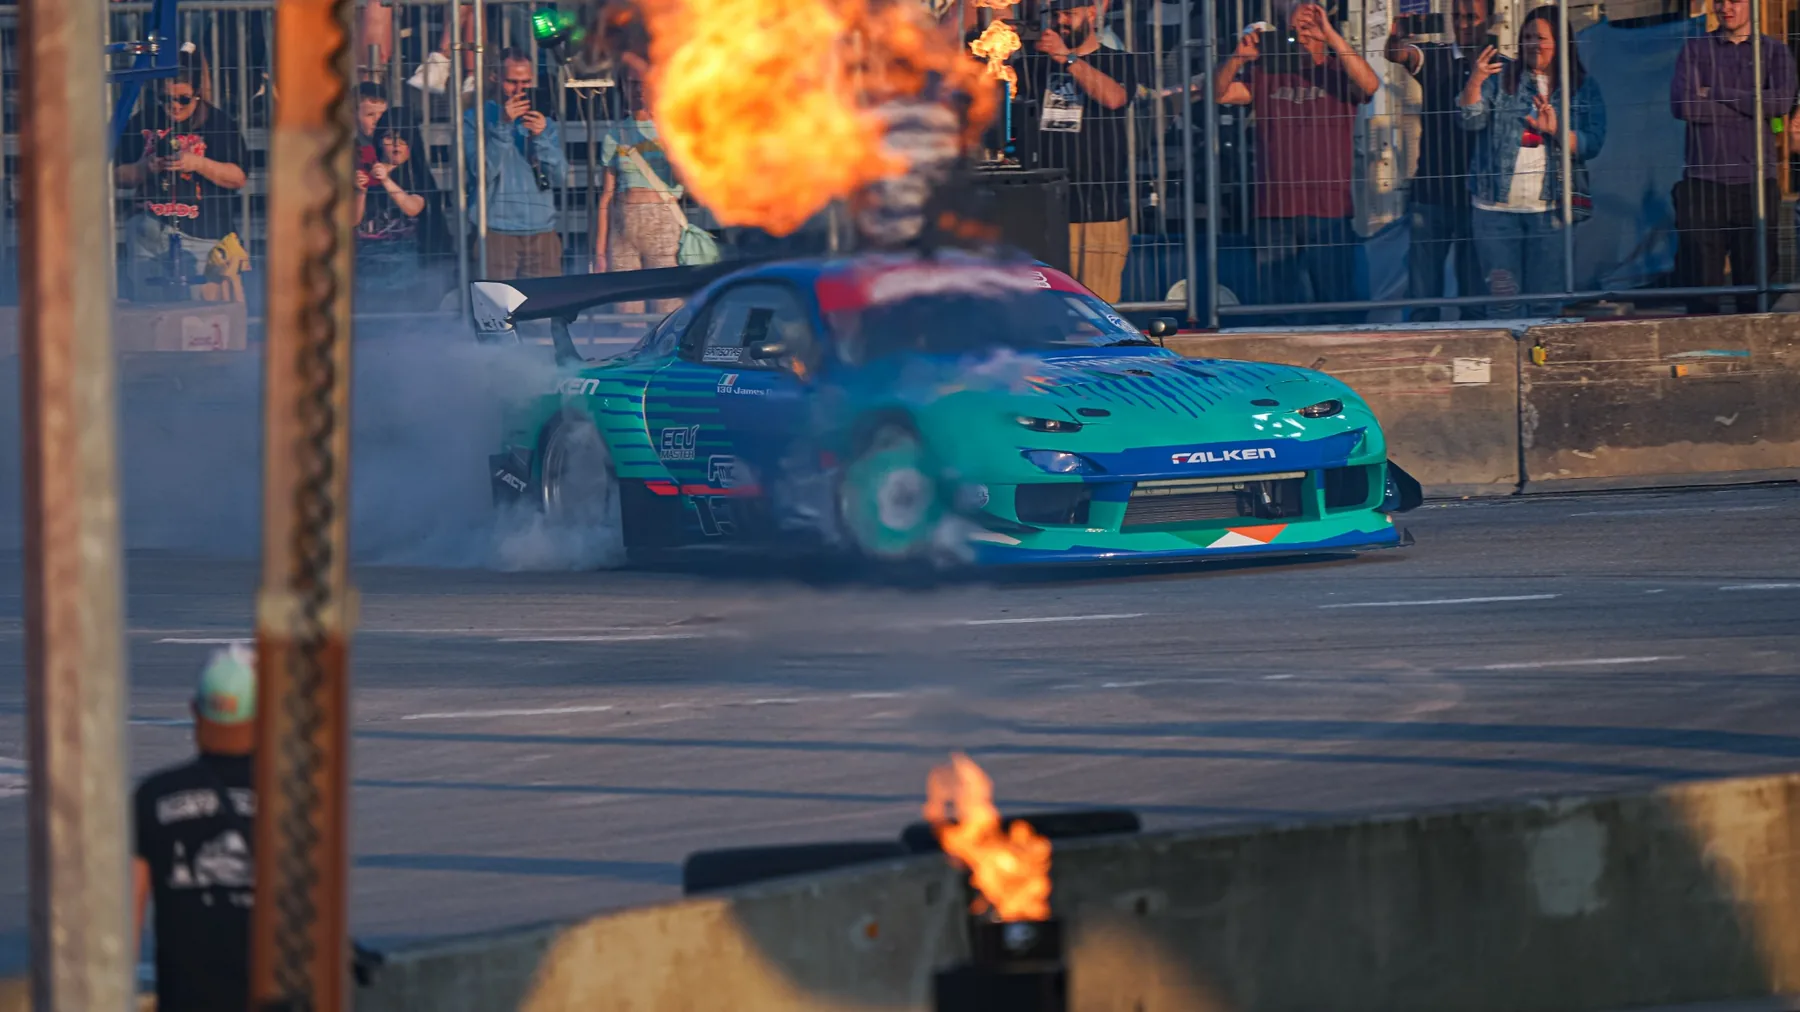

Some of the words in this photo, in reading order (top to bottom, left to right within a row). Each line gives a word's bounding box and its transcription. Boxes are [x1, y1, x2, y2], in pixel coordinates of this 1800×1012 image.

[717, 385, 732, 393] 130
[733, 386, 765, 396] James
[660, 424, 700, 450] ECU
[660, 449, 696, 460] MASTER
[1171, 447, 1276, 464] FALKEN
